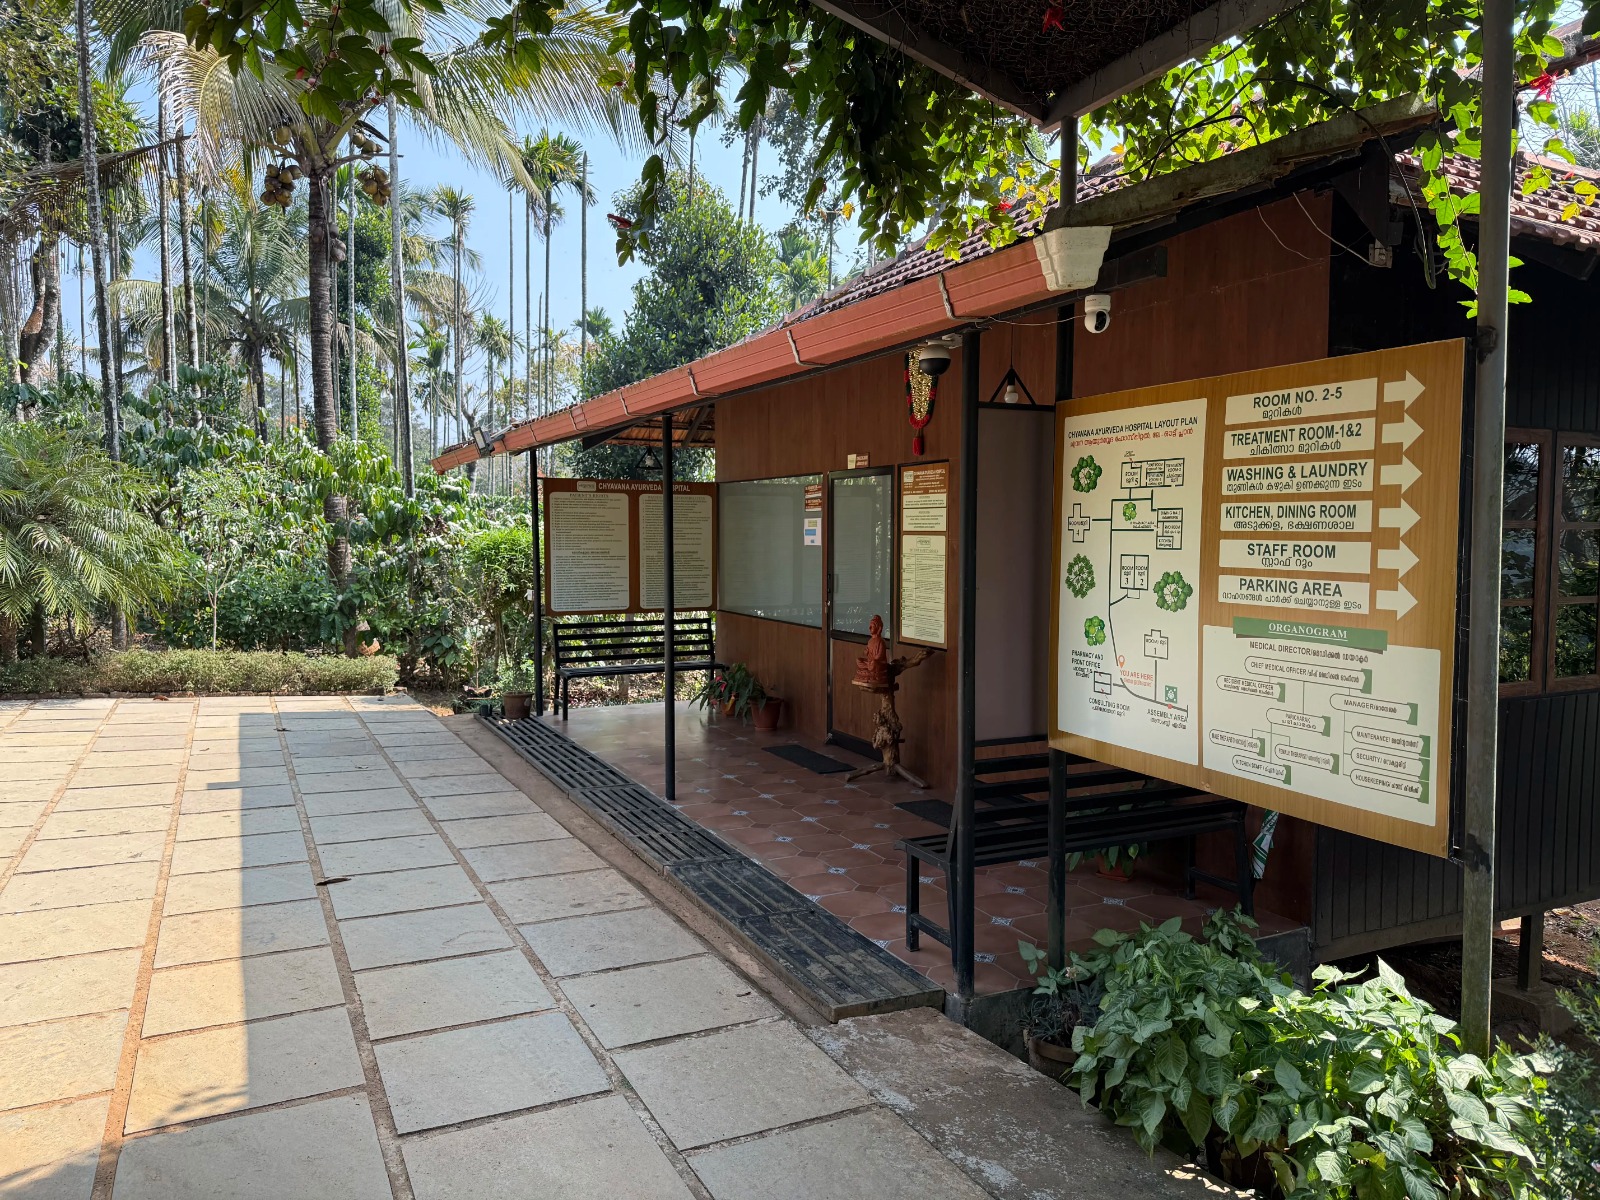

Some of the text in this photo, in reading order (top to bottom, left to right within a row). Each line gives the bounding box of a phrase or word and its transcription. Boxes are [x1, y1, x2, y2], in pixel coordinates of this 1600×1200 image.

[1253, 386, 1343, 408] ROOM NO. 2-5
[1262, 405, 1302, 420] മുറികൾ
[1095, 424, 1124, 436] AYURVEDA
[1125, 421, 1153, 432] HOSPITAL
[1154, 418, 1179, 429] LAYOUT
[1180, 416, 1198, 426] PLAN
[1231, 422, 1362, 446] TREATMENT ROOM-1&2
[1249, 439, 1341, 456] ചികിത്സാ മുറികൾ
[1227, 461, 1368, 481] WASHING & LAUNDRY
[598, 482, 630, 490] CHYAVANA
[631, 483, 662, 491] AYURVEDA
[1134, 477, 1139, 485] 5
[1226, 481, 1263, 493] തുണികൾ
[1266, 479, 1293, 492] കഴുകി
[1343, 478, 1362, 490] ഇടം
[1225, 504, 1357, 521] KITCHEN, DINING ROOM
[1233, 520, 1354, 531] അടുക്കള, ഭക്ഷണശാല
[1247, 543, 1336, 558] STAFF ROOM
[1295, 558, 1313, 569] റൂം
[1124, 577, 1129, 585] 3
[1139, 578, 1144, 586] 2
[1239, 578, 1343, 597] PARKING AREA
[1344, 601, 1362, 610] ഇടം
[1268, 622, 1348, 639] ORGANOGRAM
[1250, 641, 1276, 652] MEDICAL
[1071, 657, 1101, 669] FRONT OFFICE
[1250, 661, 1264, 669] CHIEF
[1264, 662, 1285, 673] MEDICAL
[1285, 665, 1306, 676] OFFICER
[1119, 669, 1154, 682] YOU ARE HERE
[1257, 682, 1274, 691] OFFICER
[1088, 697, 1130, 711] CONSULTING ROOM
[1146, 708, 1188, 723] ASSEMBLY AREA
